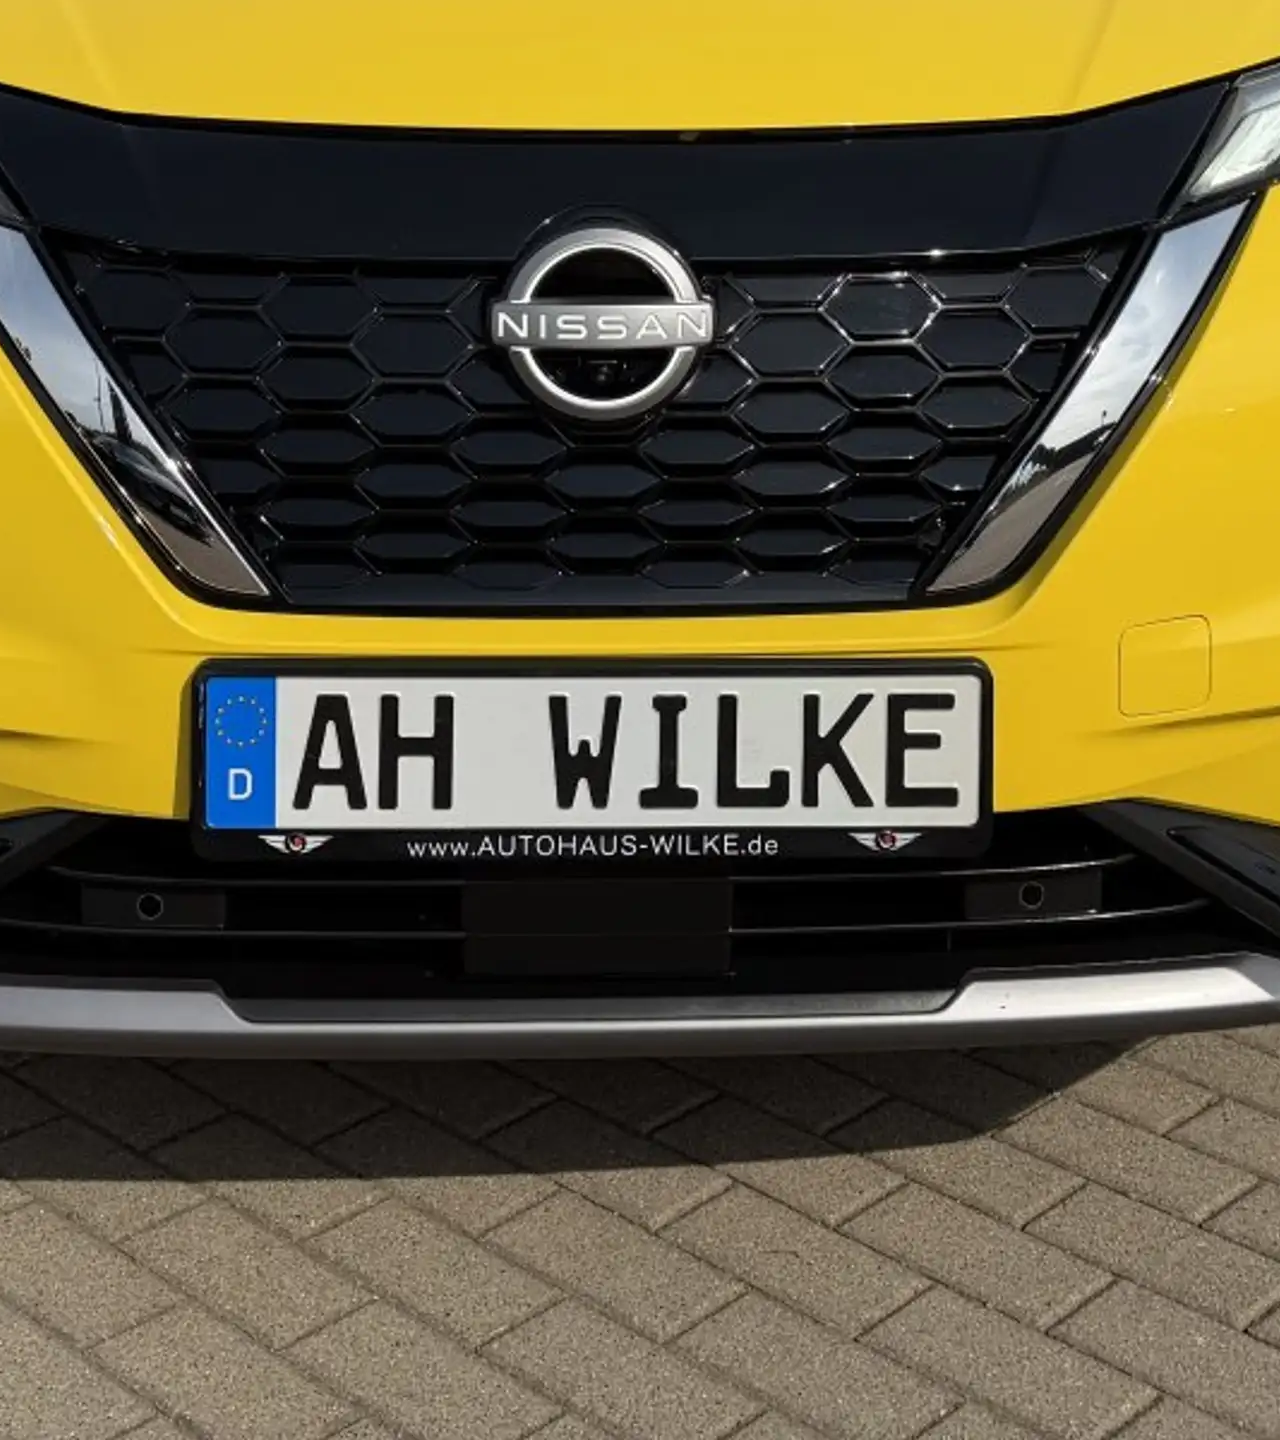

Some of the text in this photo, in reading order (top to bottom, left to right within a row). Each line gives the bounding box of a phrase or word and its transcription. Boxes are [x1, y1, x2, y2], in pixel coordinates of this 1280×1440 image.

[497, 311, 707, 340] NISSAN
[293, 693, 961, 810] AH WILKE
[228, 768, 254, 801] D
[406, 834, 780, 857] www.AUTOHAUS-WILKE.de
